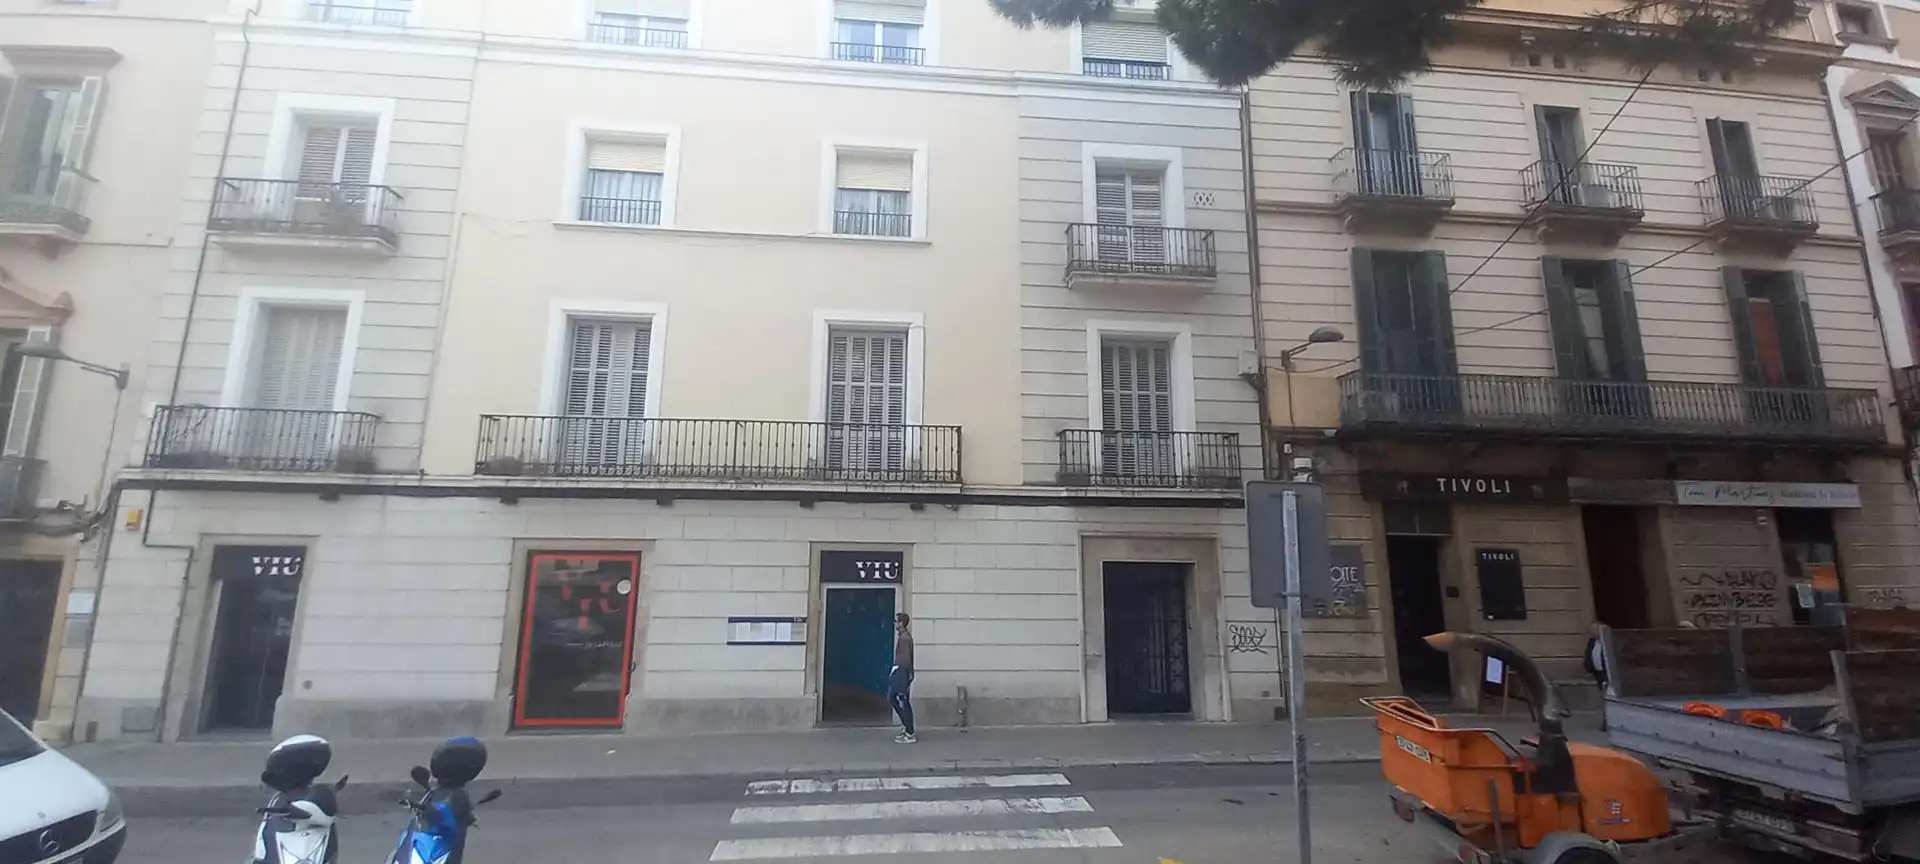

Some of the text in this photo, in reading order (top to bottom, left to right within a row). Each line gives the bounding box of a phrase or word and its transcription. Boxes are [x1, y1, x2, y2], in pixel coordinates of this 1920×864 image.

[1437, 477, 1511, 494] TIVOLI
[1481, 551, 1515, 561] TIVOLI
[252, 556, 302, 576] VIU
[855, 560, 900, 579] VIU
